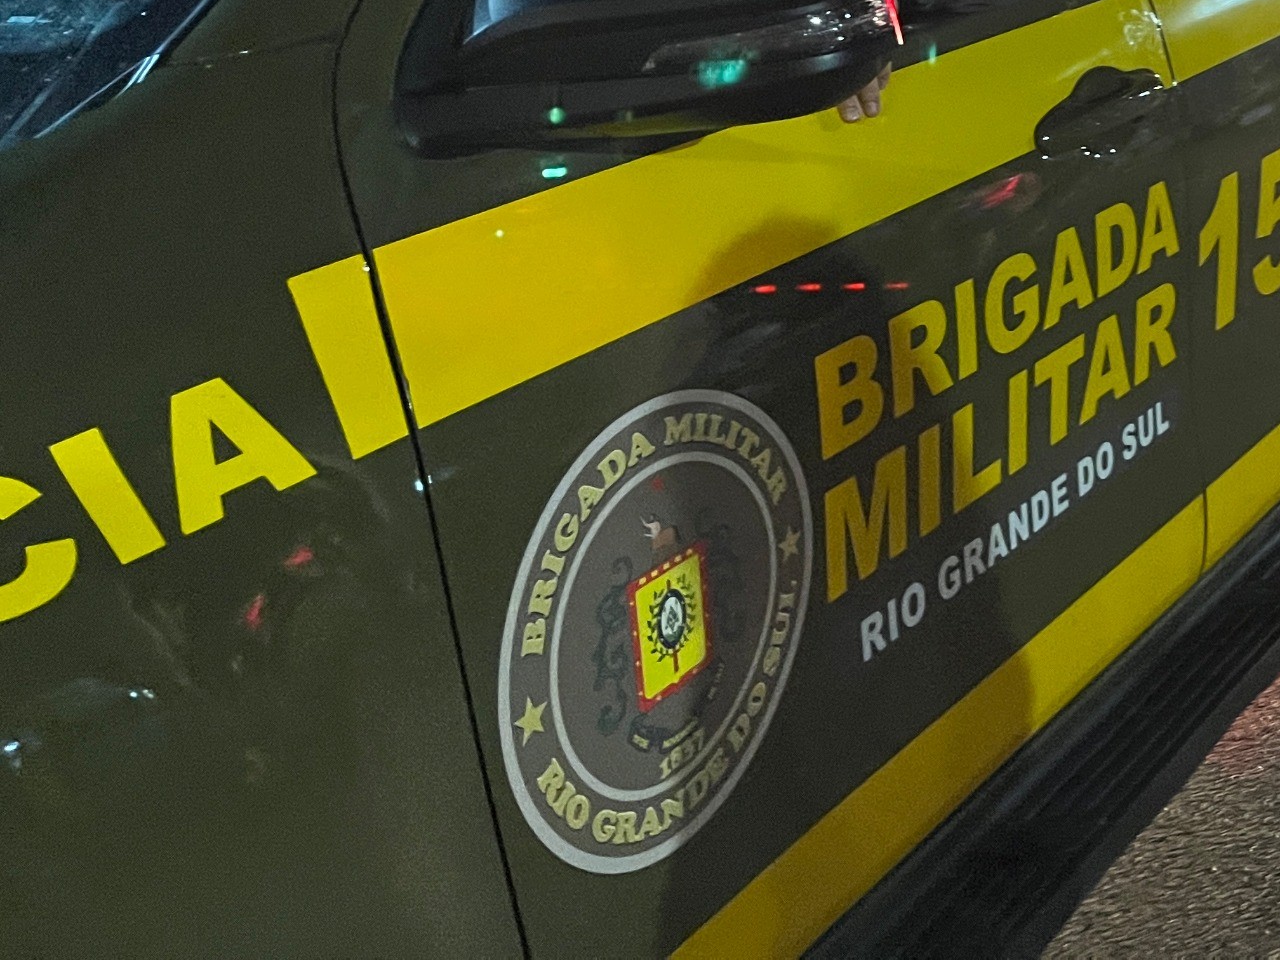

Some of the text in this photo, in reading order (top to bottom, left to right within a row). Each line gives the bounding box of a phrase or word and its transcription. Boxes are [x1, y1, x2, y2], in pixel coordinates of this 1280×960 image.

[814, 181, 1180, 461] BRIGADA
[824, 282, 1178, 603] MILITAR
[521, 413, 786, 657] BRIGADA MILITAR
[860, 402, 1169, 662] RIO GRANDE DO SUL
[537, 758, 590, 830] RIO
[592, 747, 730, 844] GRANDE
[727, 682, 766, 752] DO
